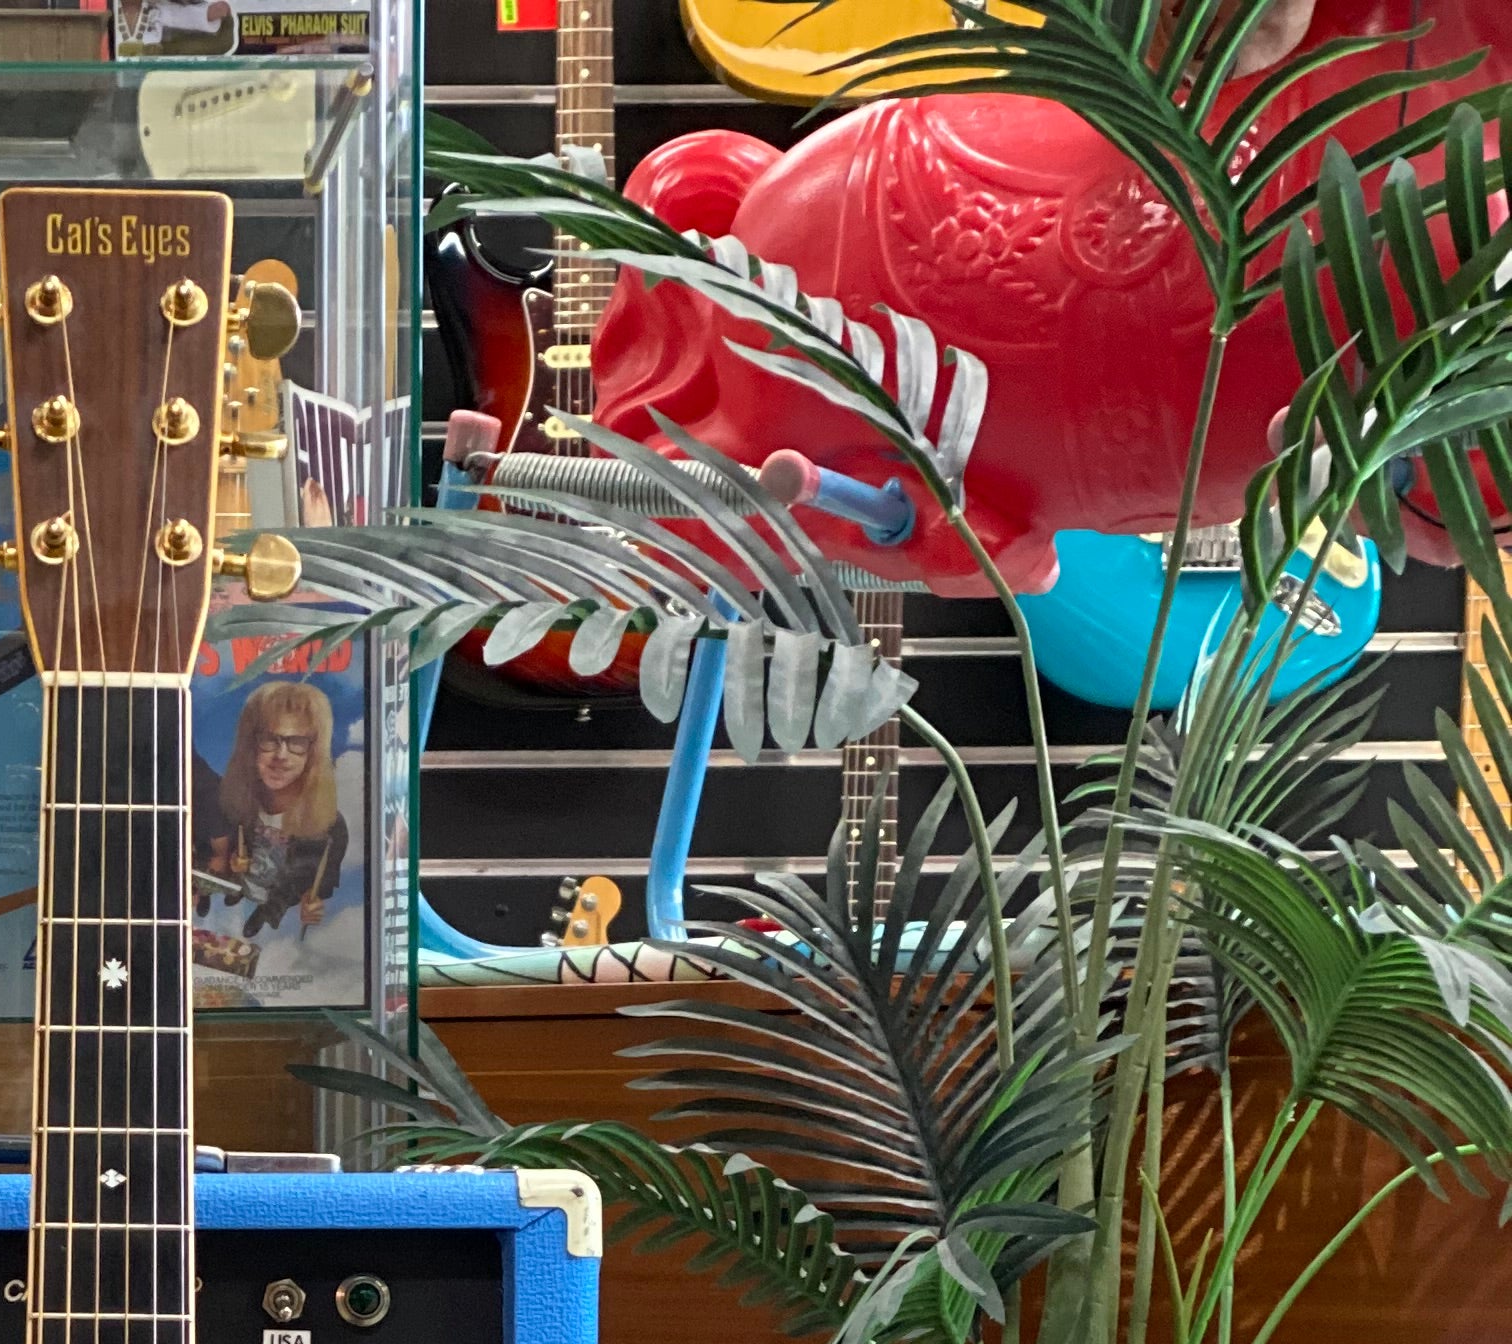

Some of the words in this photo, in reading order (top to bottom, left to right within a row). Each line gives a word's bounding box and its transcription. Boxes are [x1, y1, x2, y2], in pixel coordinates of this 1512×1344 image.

[241, 15, 274, 36] ELVIS
[280, 14, 337, 36] PHARAOH
[340, 13, 368, 35] SUIT
[121, 215, 191, 264] Eyes
